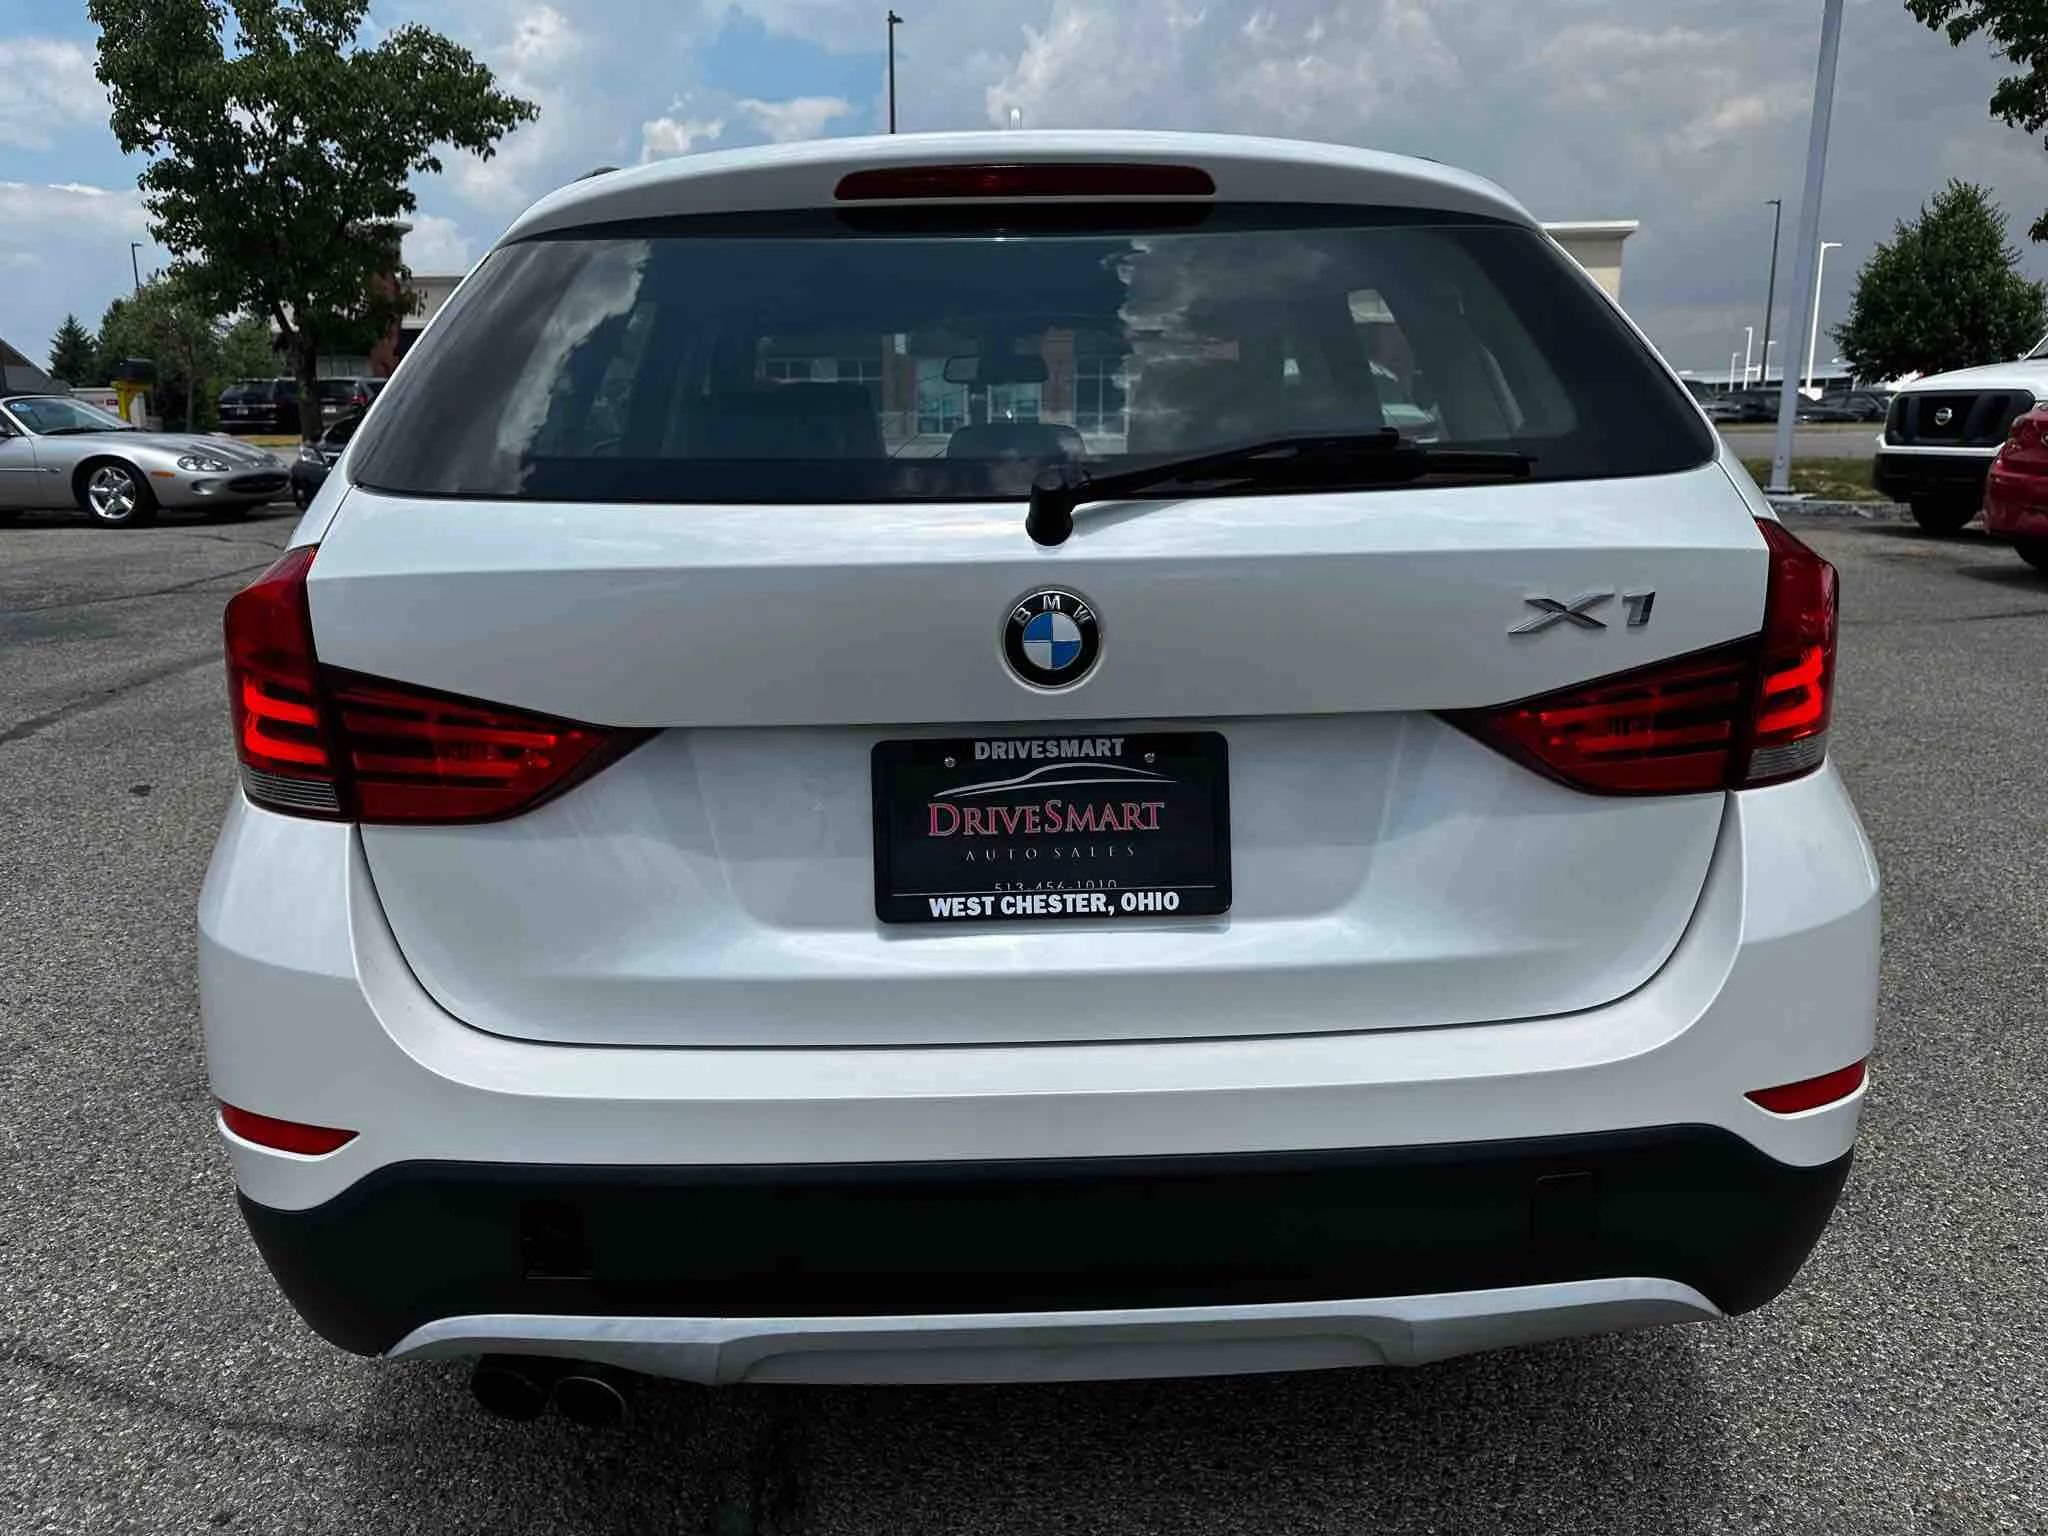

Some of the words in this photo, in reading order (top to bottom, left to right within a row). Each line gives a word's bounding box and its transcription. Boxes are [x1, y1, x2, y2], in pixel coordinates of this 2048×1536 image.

[1013, 595, 1091, 626] BMW
[1507, 591, 1656, 634] X1
[975, 738, 1124, 760] DRIVESMART
[965, 847, 1038, 863] AUTO
[1053, 845, 1135, 860] SALES
[929, 895, 995, 918] WEST
[1000, 892, 1116, 917] CHESTER,
[1120, 891, 1180, 912] OHIO
